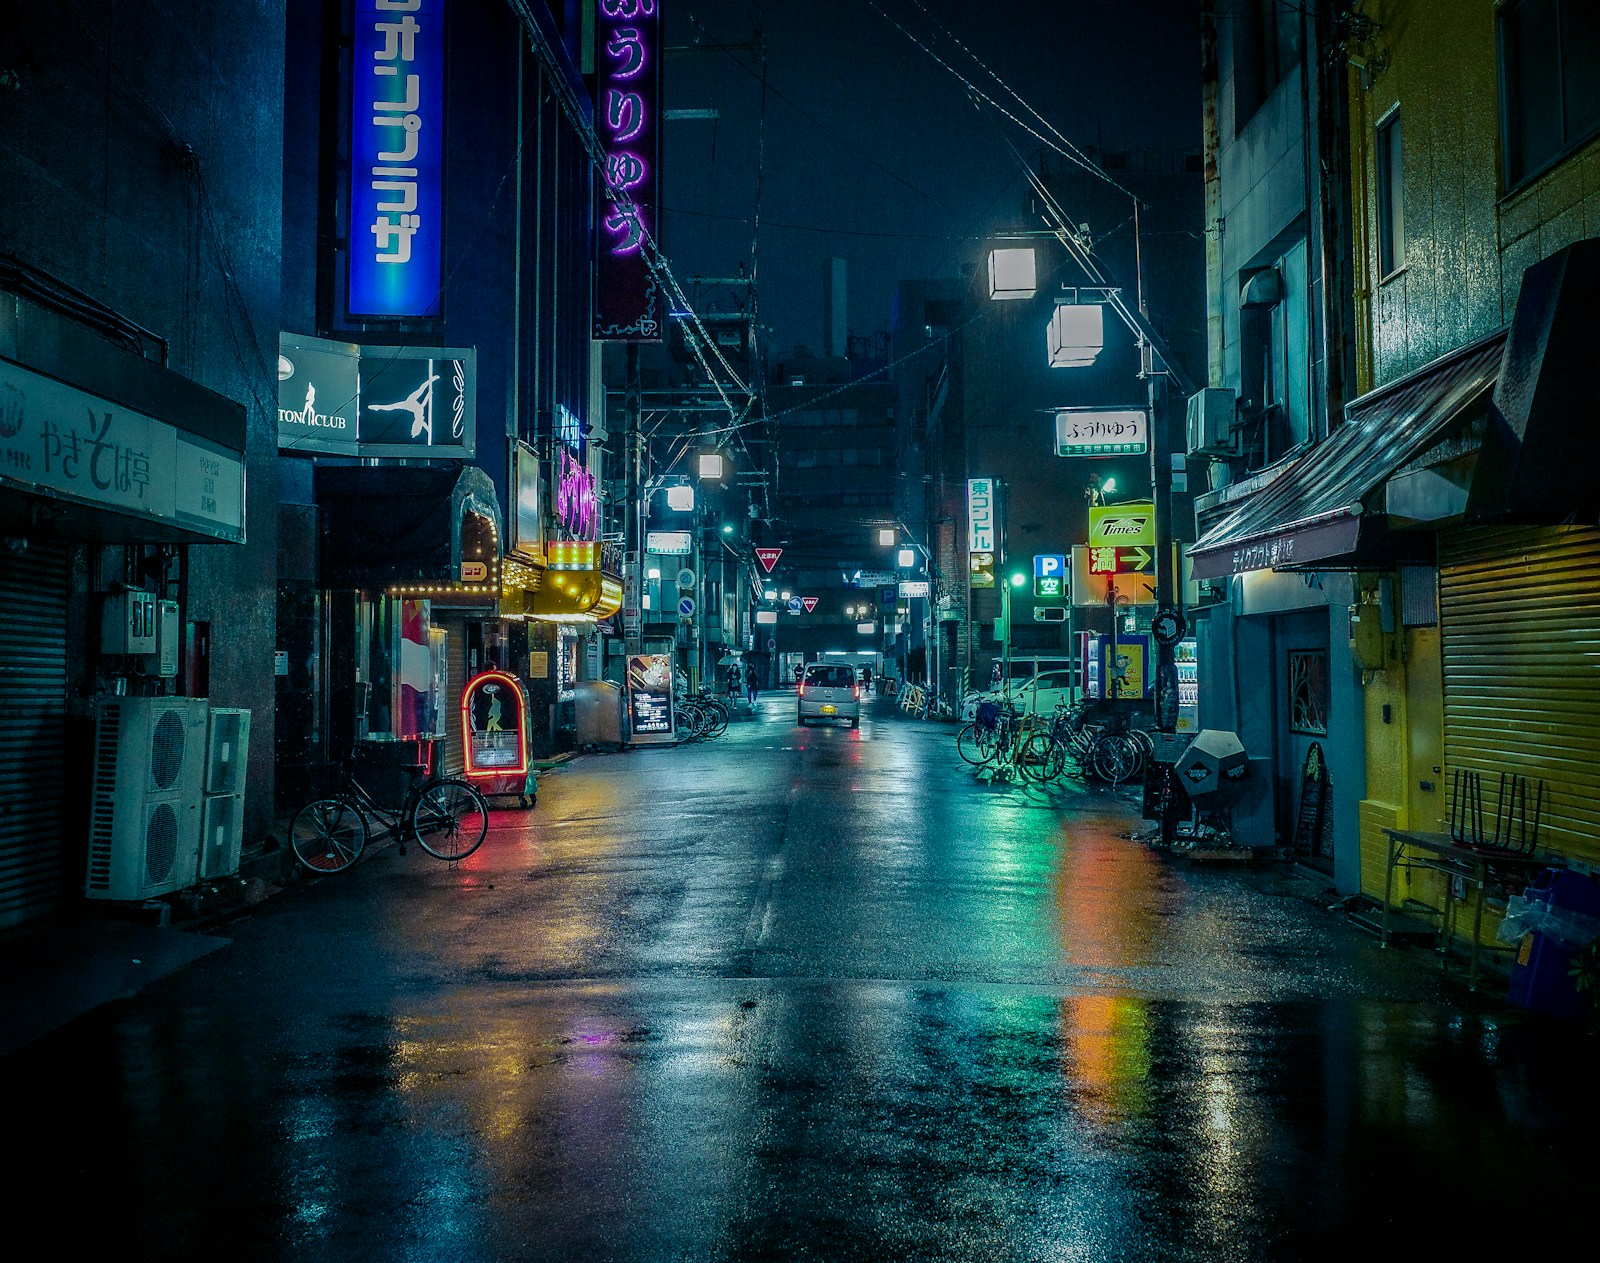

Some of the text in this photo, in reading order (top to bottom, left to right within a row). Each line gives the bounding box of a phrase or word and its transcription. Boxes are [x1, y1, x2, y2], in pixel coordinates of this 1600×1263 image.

[371, 0, 421, 263] オンプラザ
[314, 414, 346, 429] CLUB
[40, 406, 150, 499] やきそば亭
[1064, 443, 1142, 454] 十三西栄町商店街
[971, 481, 990, 550] 東コントル
[1101, 518, 1148, 536] Times
[761, 552, 777, 560] 止まれ
[971, 553, 993, 571] P
[1091, 547, 1117, 573] 満
[1042, 557, 1059, 576] P
[1040, 577, 1059, 595] 空
